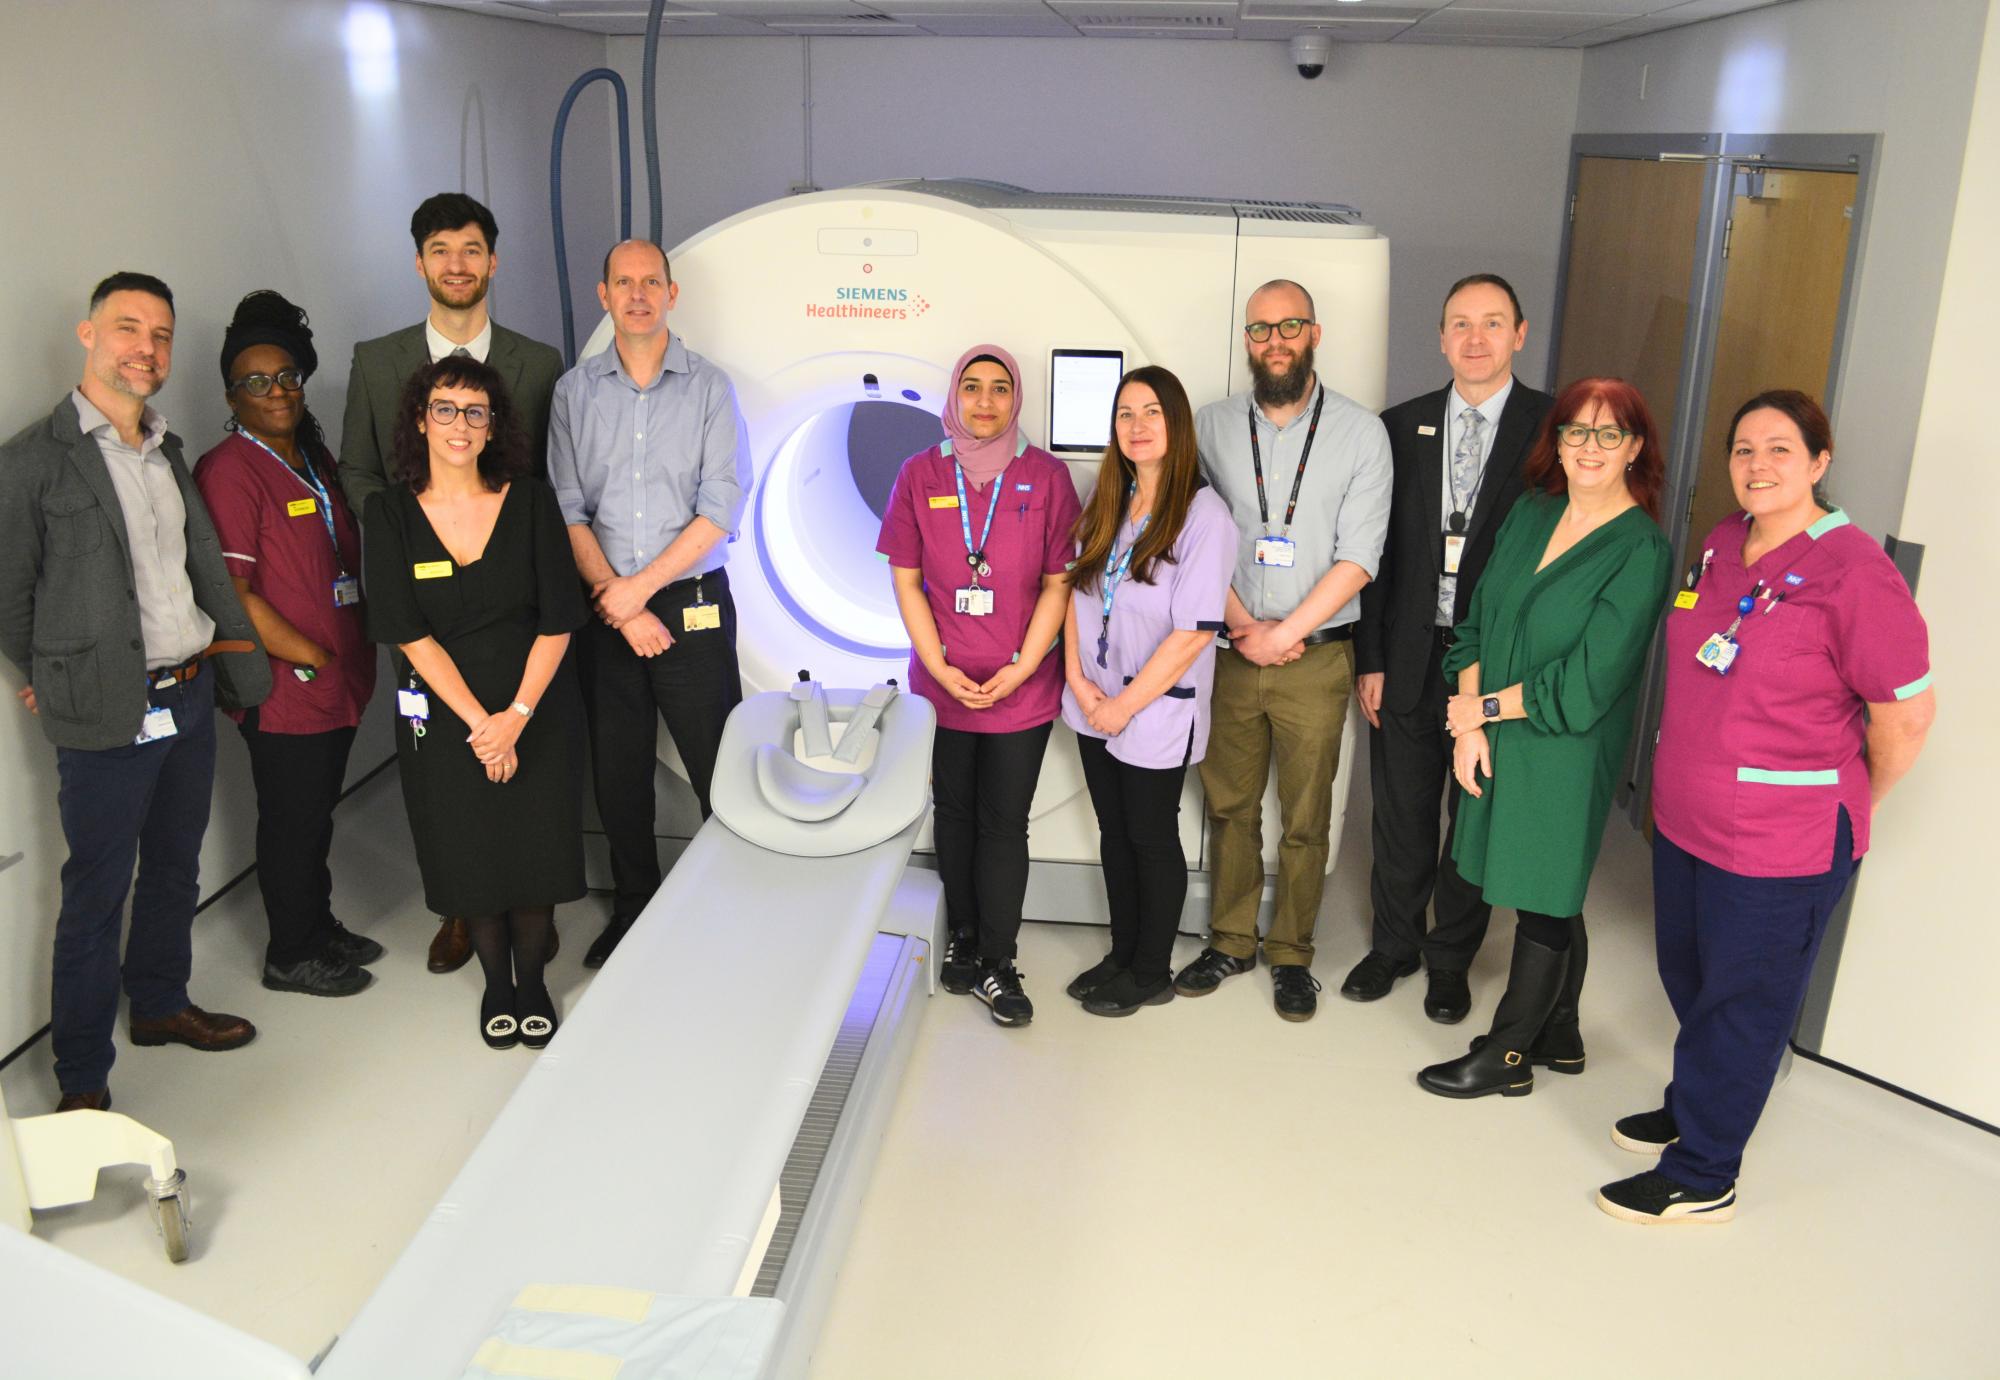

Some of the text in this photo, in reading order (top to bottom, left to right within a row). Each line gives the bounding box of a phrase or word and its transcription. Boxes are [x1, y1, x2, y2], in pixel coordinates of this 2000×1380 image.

[836, 287, 907, 301] SIEMENS
[806, 303, 907, 320] Healthineers
[1017, 484, 1030, 492] NHS
